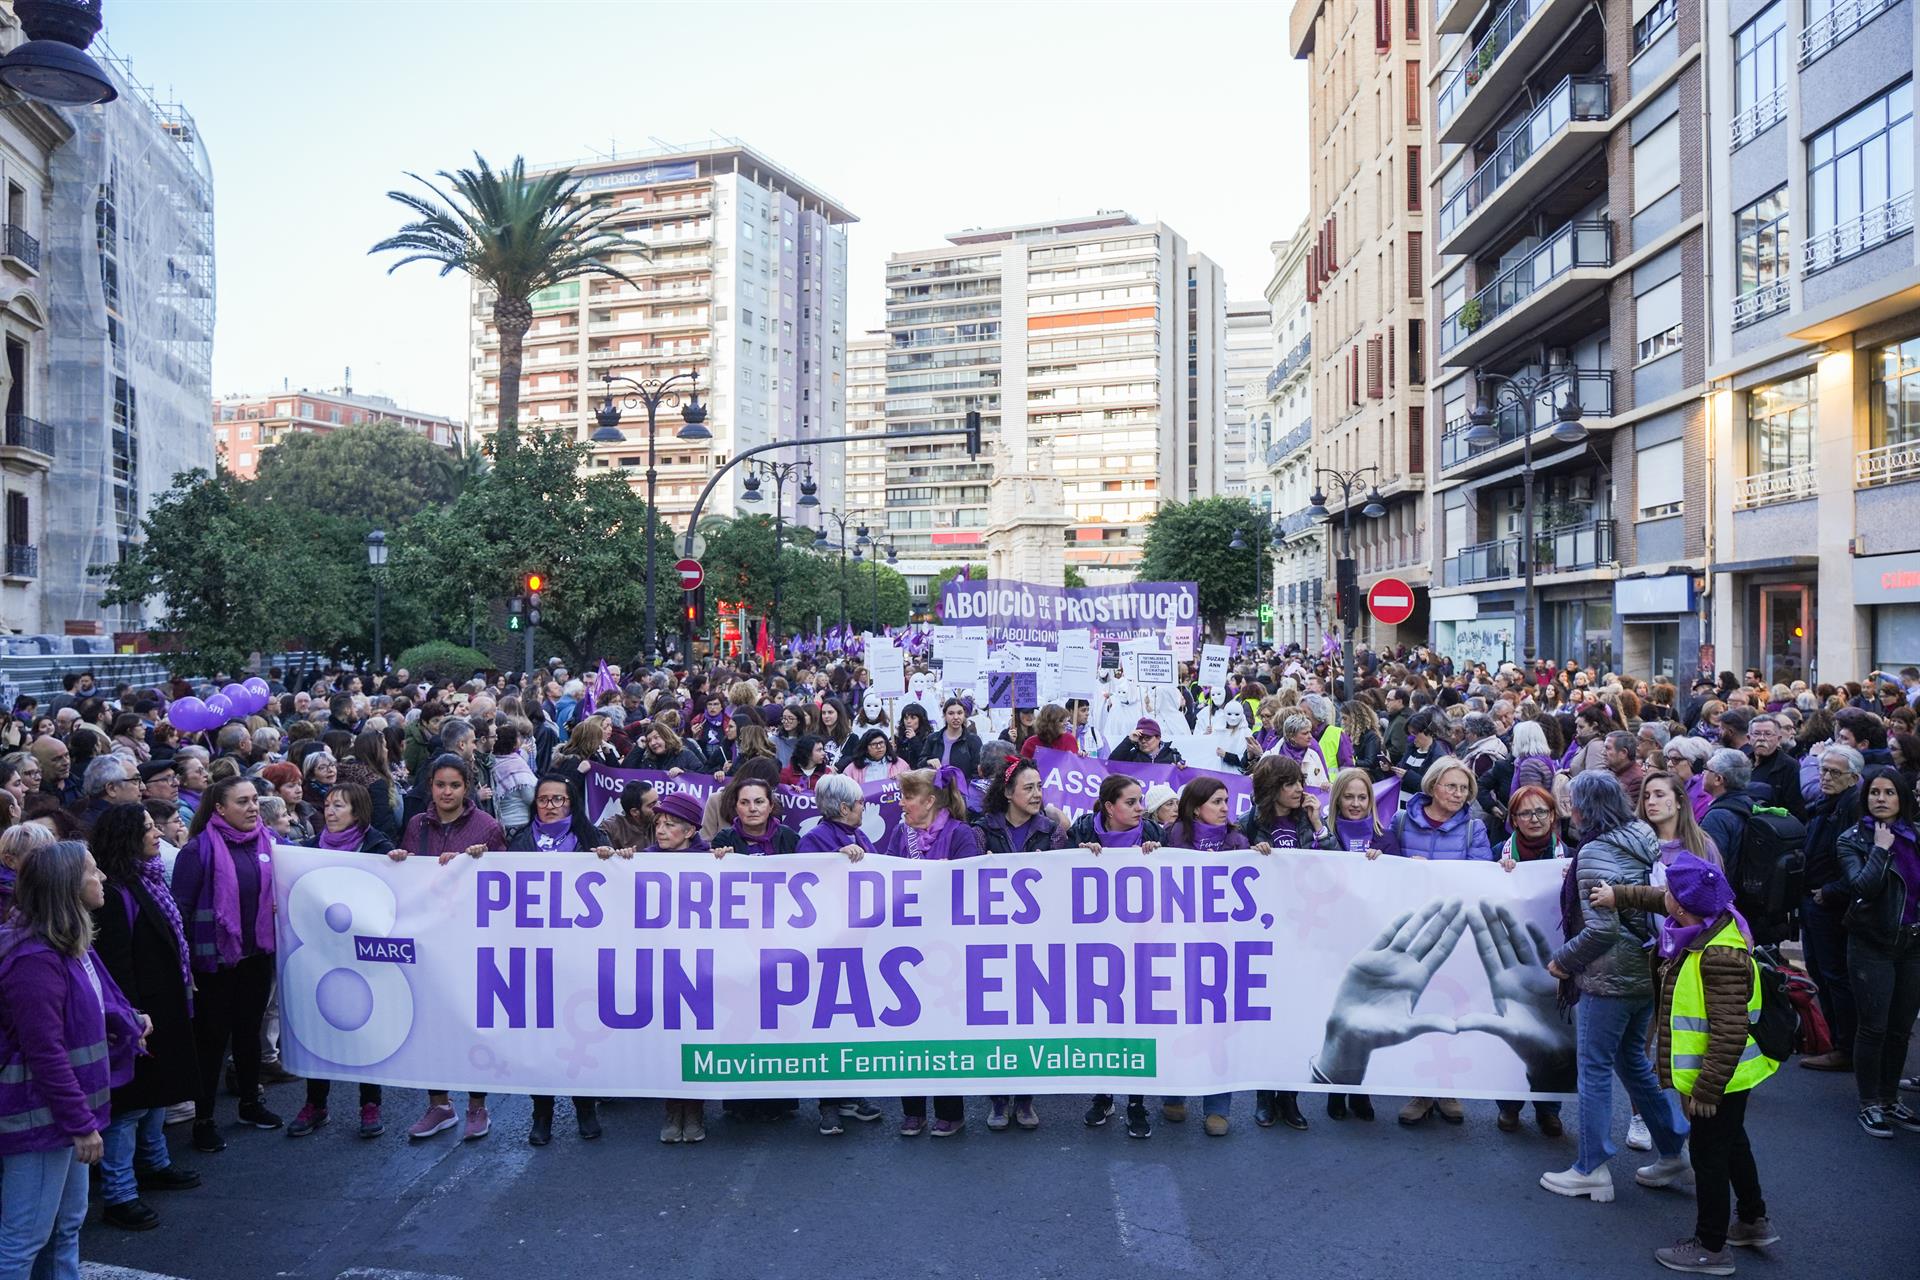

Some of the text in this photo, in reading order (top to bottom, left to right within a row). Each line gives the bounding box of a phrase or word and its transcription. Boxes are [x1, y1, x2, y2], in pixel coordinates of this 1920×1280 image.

[598, 172, 641, 187] urbano
[1038, 594, 1051, 608] DE
[1039, 606, 1052, 620] LA
[1001, 627, 1058, 644] ABOLICIONI
[594, 771, 625, 793] NOS
[1278, 839, 1295, 847] UGT
[476, 865, 1274, 930] PELS DRETS DE LES DONES,
[358, 940, 413, 963] MARÇ
[476, 940, 1274, 1031] NI UN PAS ENRERE
[693, 1043, 1146, 1077] Moviment Feminista de València
